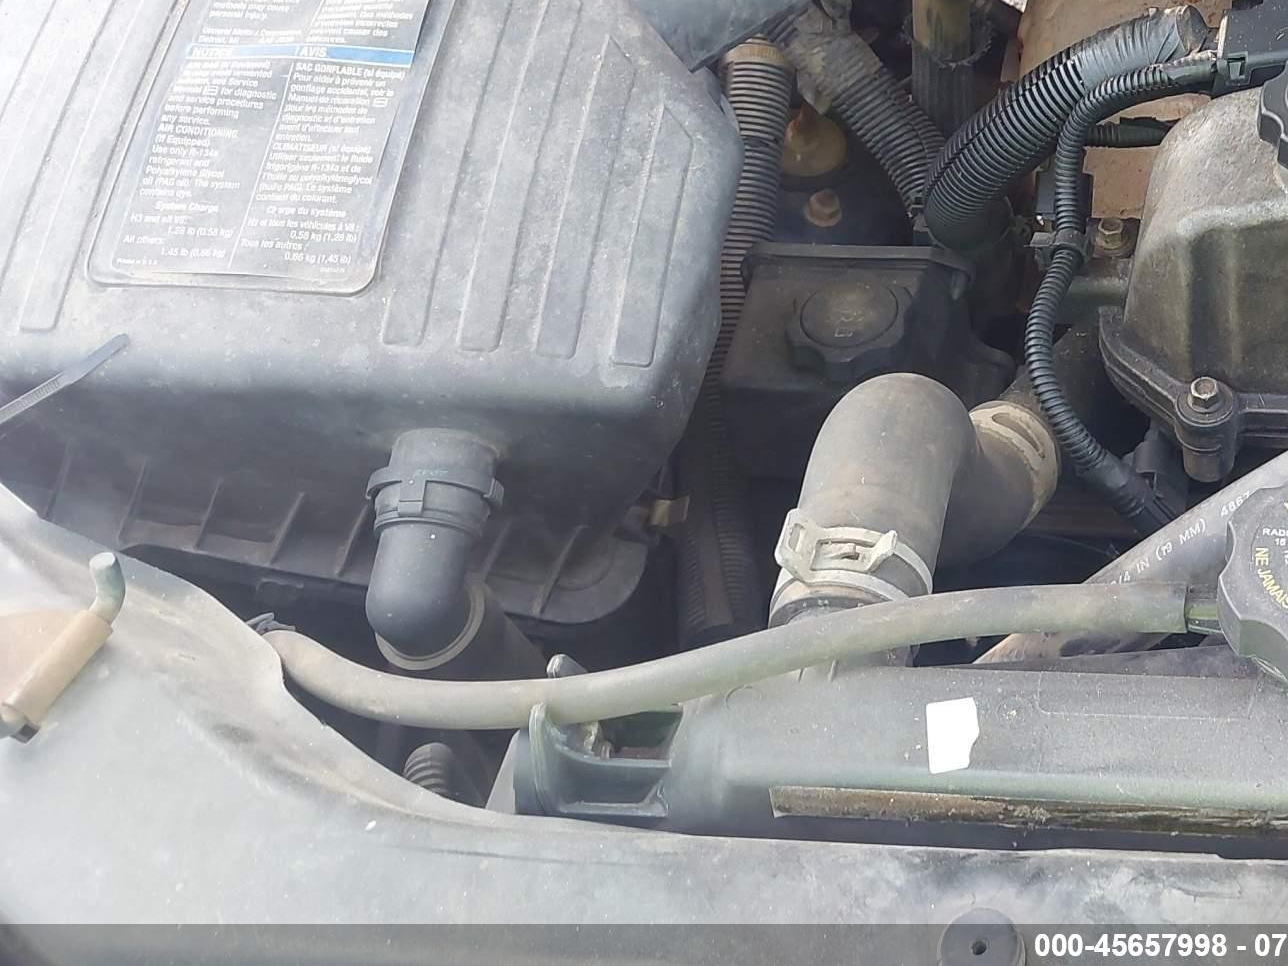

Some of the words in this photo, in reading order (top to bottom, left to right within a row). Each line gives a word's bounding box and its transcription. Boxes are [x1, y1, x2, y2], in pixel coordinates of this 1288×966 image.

[300, 47, 327, 57] AVIS
[295, 62, 312, 71] SAC
[314, 65, 363, 76] GONFLABLE
[234, 88, 277, 100] diagnostic
[216, 97, 264, 110] procedures
[193, 106, 240, 120] performing
[157, 123, 174, 132] AIR
[175, 125, 239, 139] CONDITIONING
[1135, 558, 1150, 574] IN
[1179, 518, 1206, 546] MM)
[1255, 547, 1270, 566] NE
